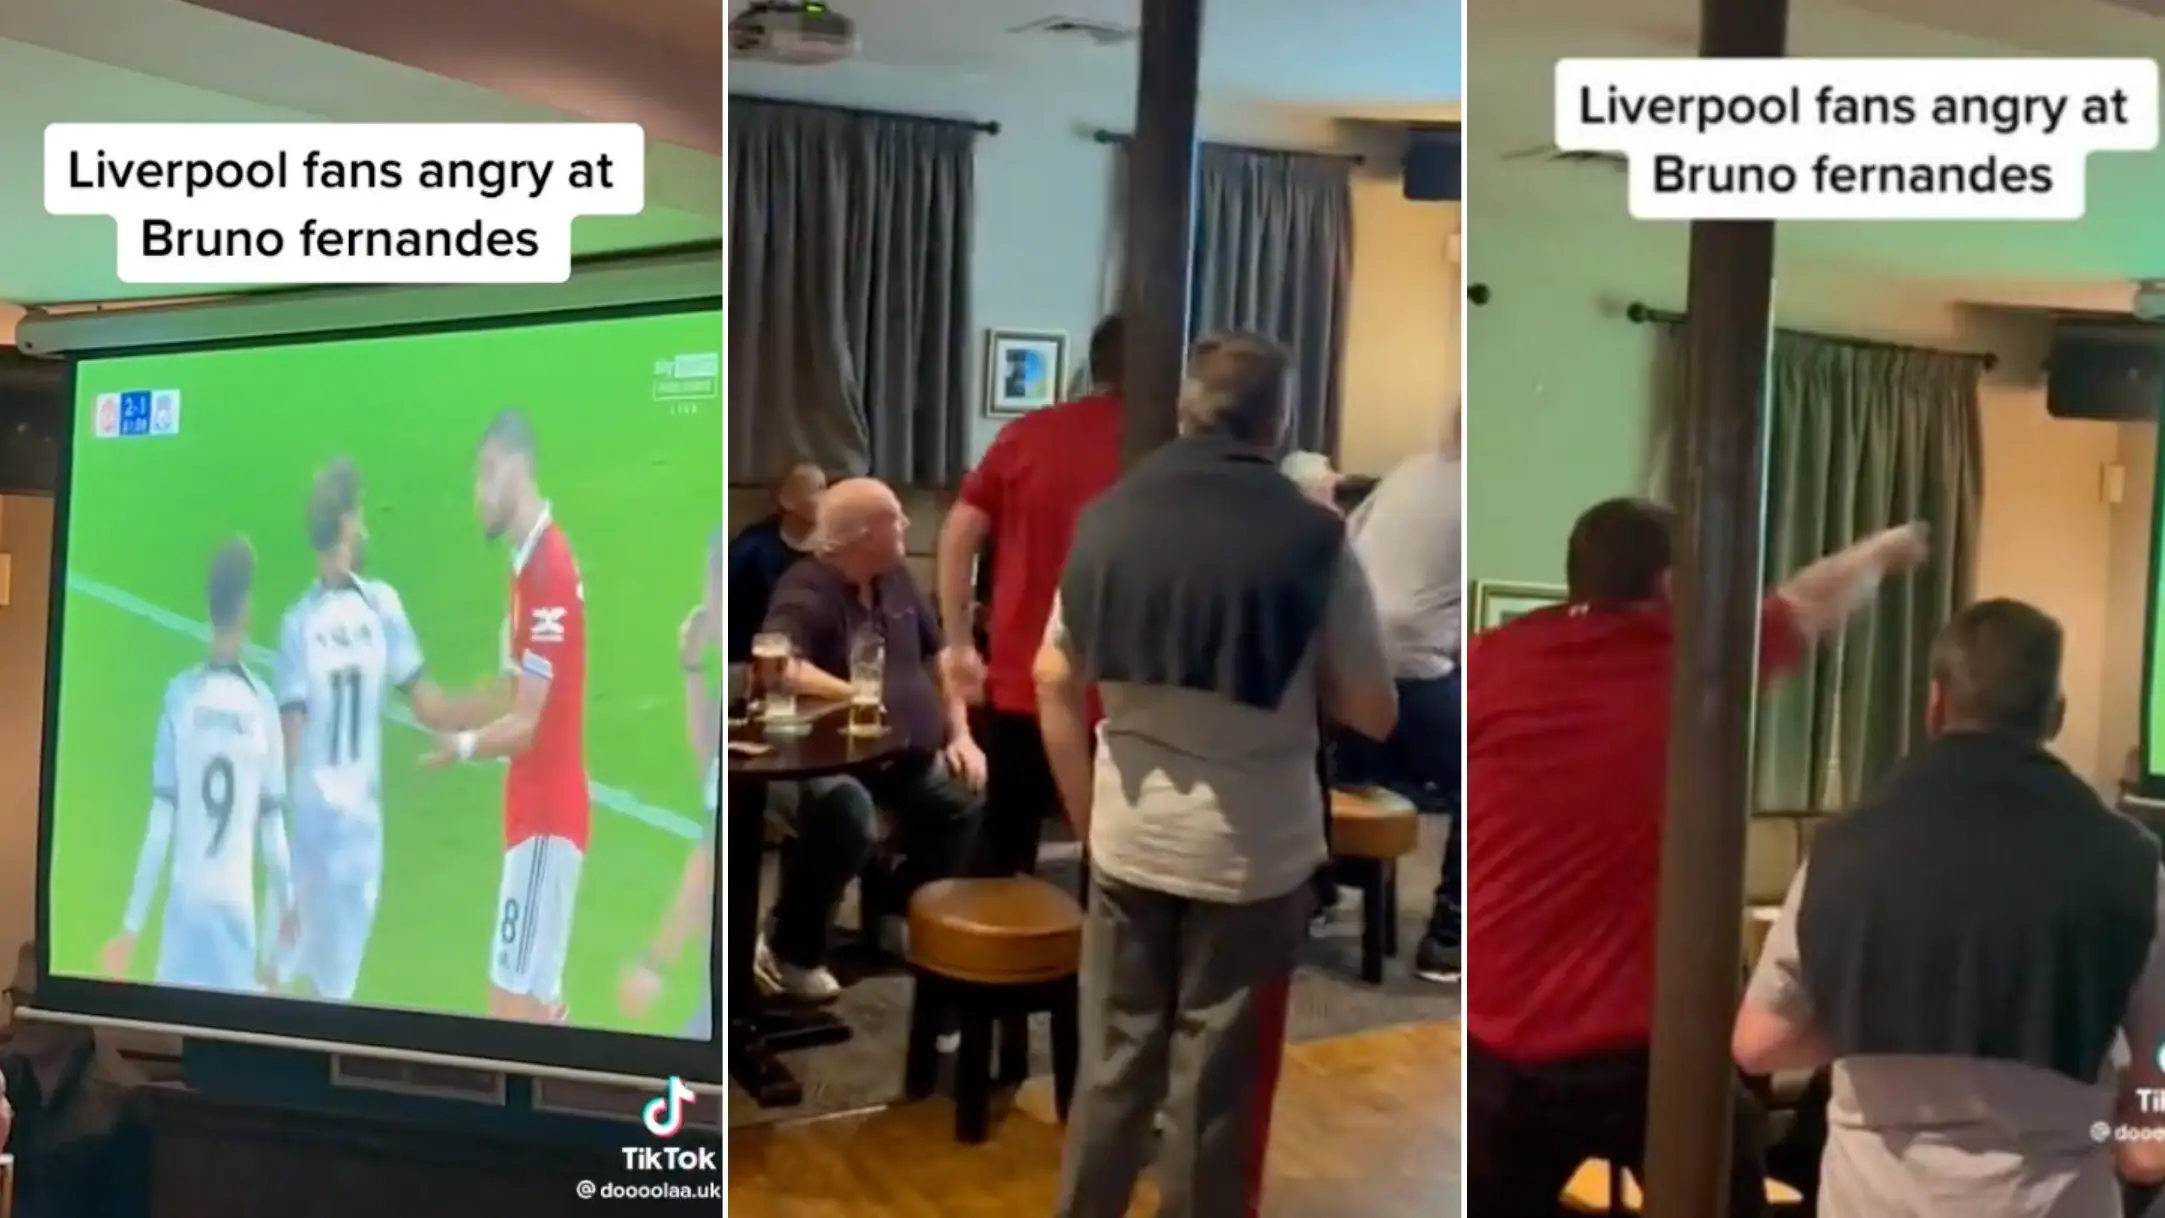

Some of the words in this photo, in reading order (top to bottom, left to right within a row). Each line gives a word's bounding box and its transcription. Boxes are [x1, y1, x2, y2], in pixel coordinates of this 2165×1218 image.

[329, 667, 361, 766] 11
[202, 757, 234, 857] 9
[502, 898, 519, 942] 8
